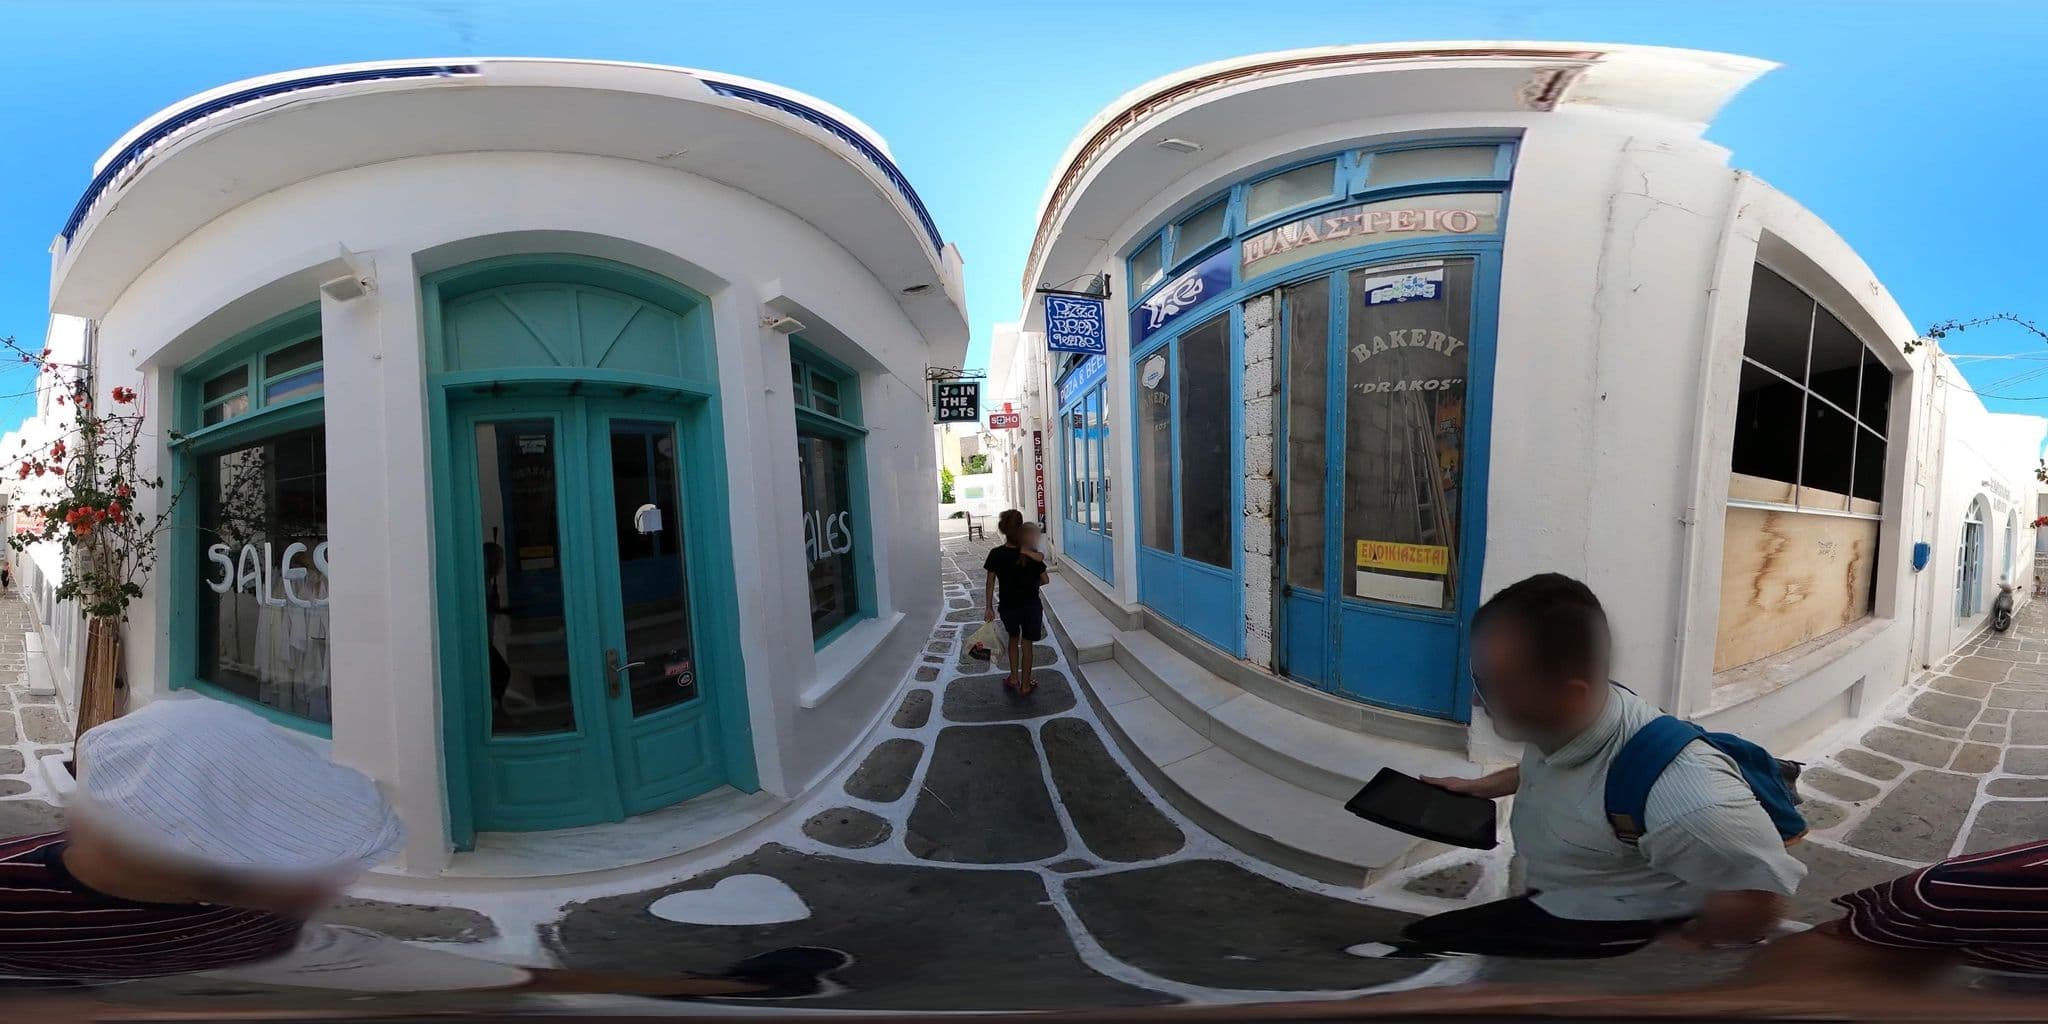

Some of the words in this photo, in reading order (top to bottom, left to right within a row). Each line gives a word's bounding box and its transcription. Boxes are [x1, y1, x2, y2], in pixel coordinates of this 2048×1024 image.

[1351, 329, 1464, 363] BAKERY
[1086, 353, 1105, 379] BEE
[941, 386, 975, 396] JOIN
[1353, 379, 1462, 394] "DRAKOS"
[941, 397, 968, 407] THE
[941, 408, 975, 417] DOTS
[1036, 476, 1045, 507] CAFE
[803, 510, 852, 561] ALES
